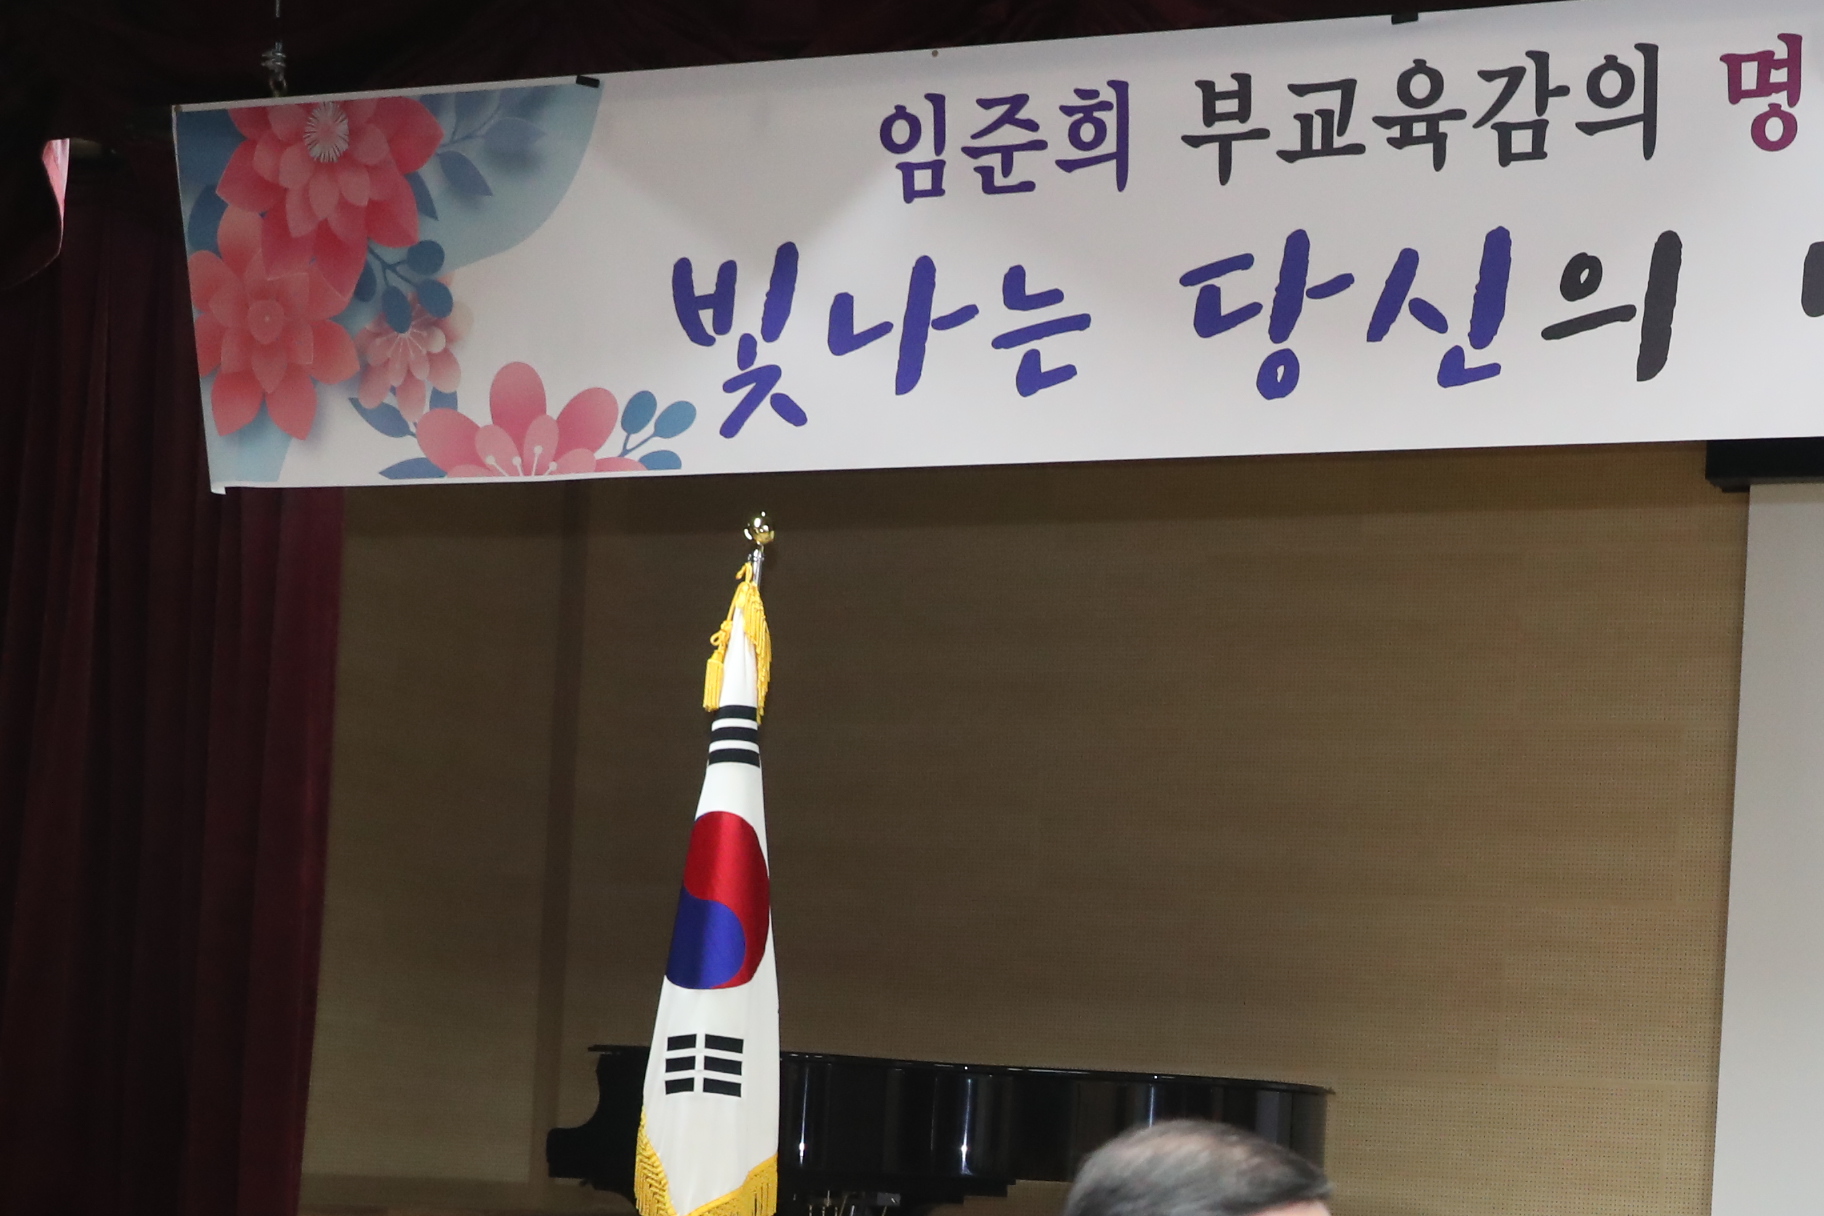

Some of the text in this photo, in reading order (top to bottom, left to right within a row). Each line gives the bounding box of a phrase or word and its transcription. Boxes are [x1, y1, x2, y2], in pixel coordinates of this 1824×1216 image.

[878, 78, 1132, 203] 임준희
[1181, 41, 1660, 187] 부교육감의
[671, 240, 1091, 439] 빛나는
[1179, 225, 1683, 401] 당신의
